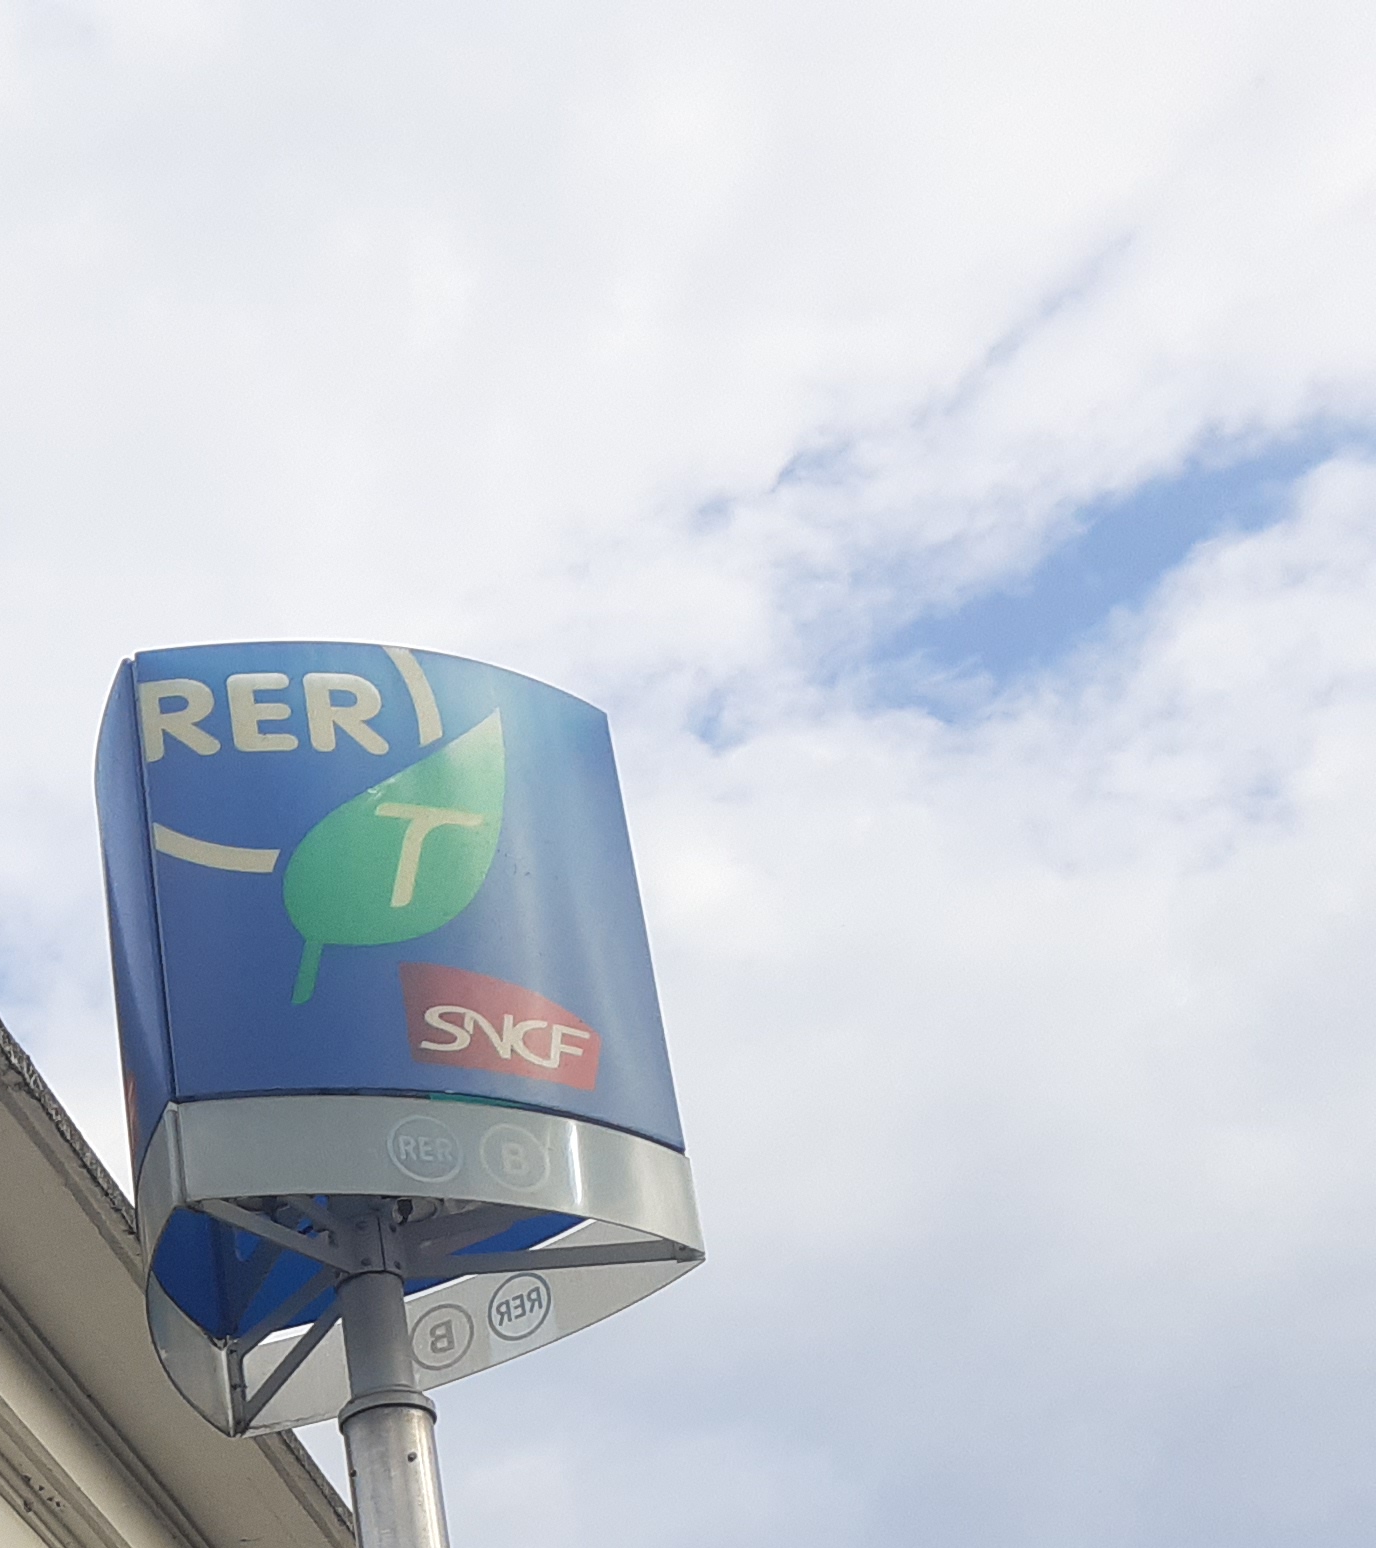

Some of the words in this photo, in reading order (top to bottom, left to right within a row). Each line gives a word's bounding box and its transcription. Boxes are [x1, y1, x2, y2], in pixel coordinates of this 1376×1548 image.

[138, 671, 390, 764] RER
[375, 802, 486, 909] T
[420, 1004, 591, 1069] SNCF
[398, 1134, 454, 1163] RER
[501, 1141, 534, 1179] B
